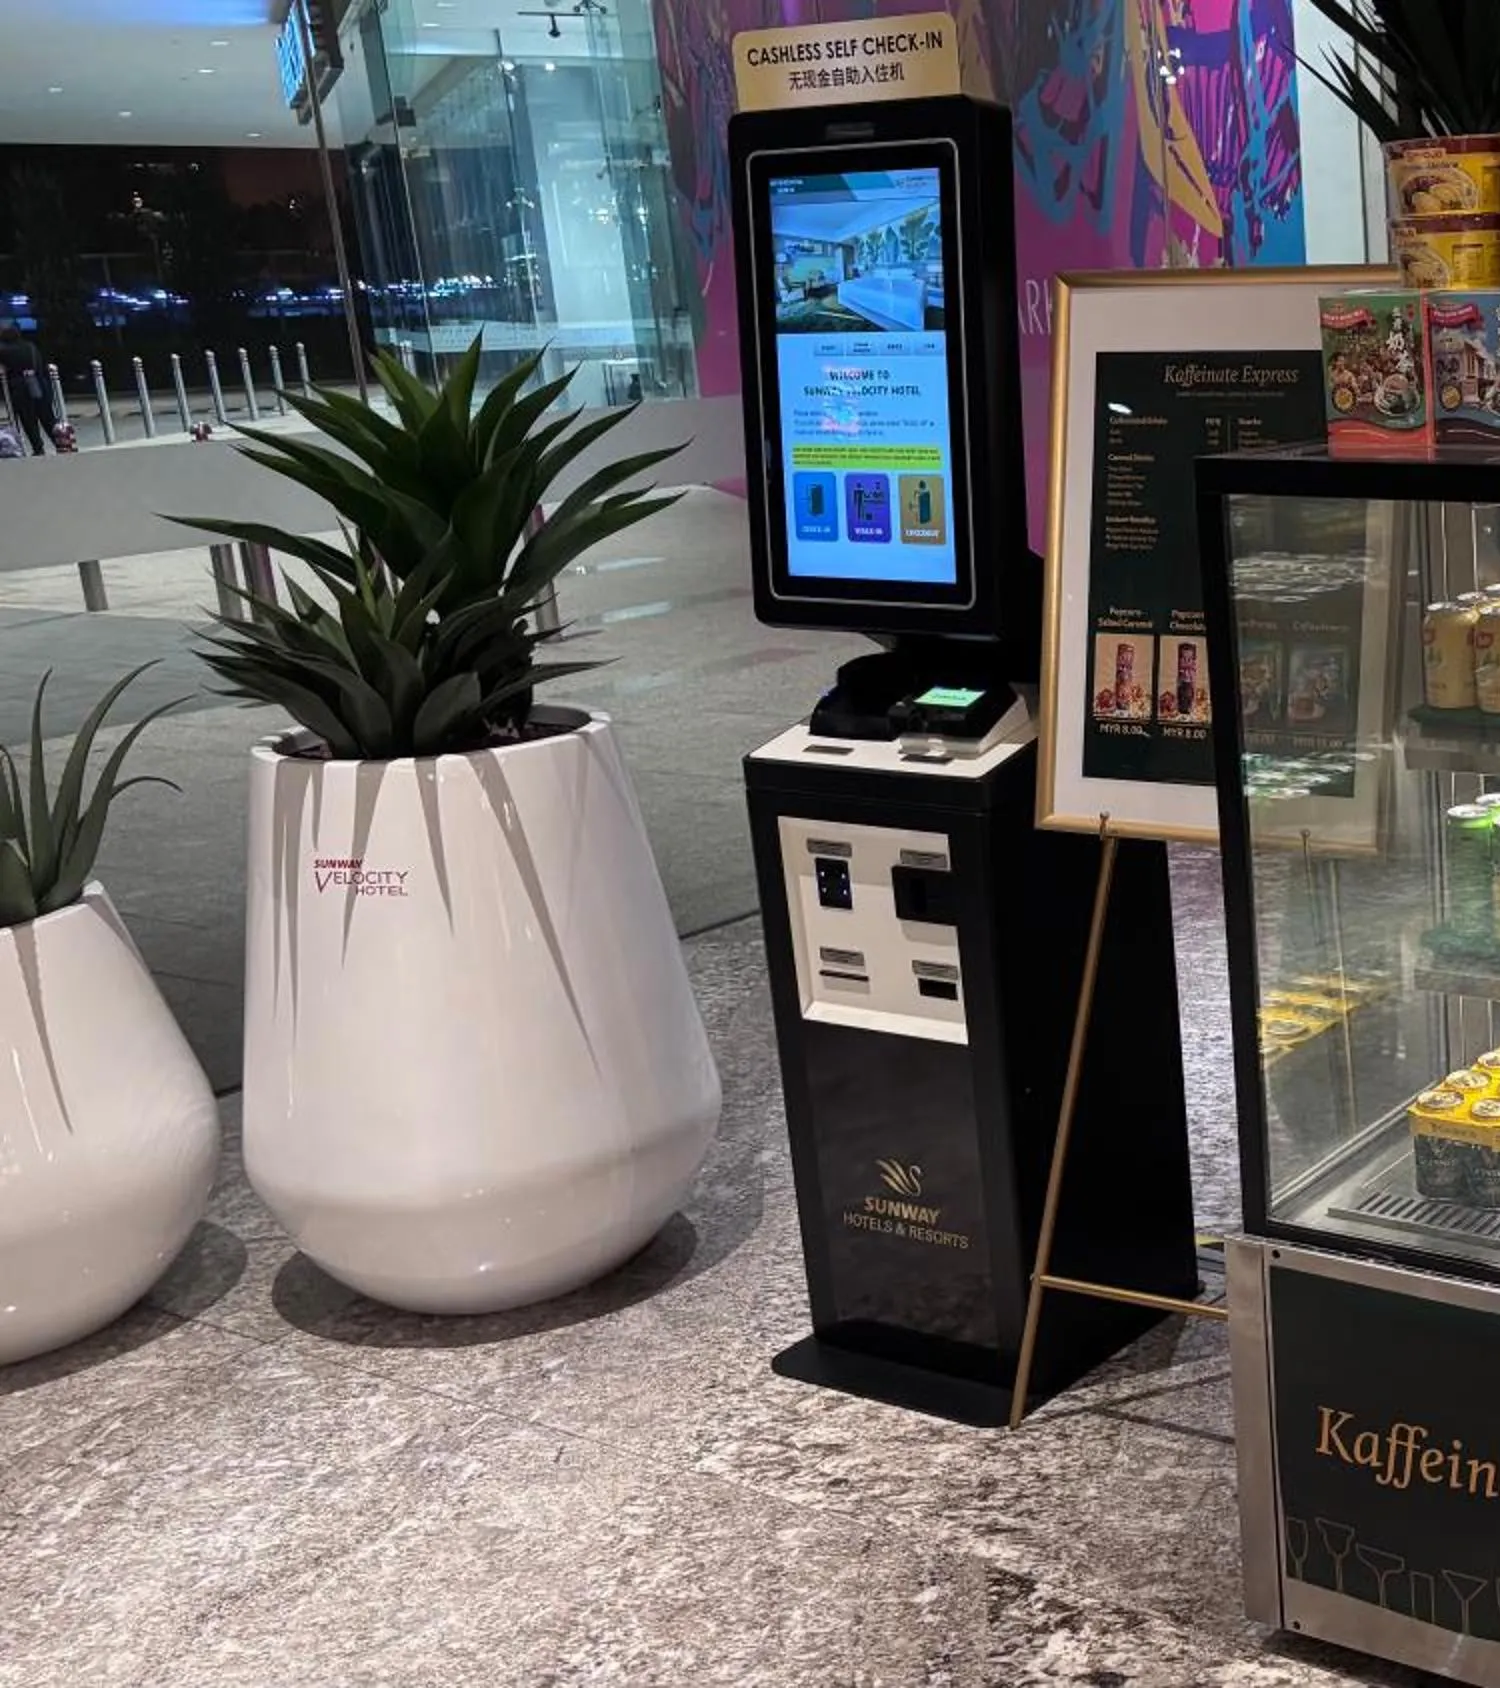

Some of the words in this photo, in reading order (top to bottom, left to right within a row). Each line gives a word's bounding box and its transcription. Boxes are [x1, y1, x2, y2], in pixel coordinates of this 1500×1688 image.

[747, 41, 822, 66] CASHLESS
[825, 39, 857, 61] SELF
[863, 31, 943, 56] CHECK-IN
[789, 62, 905, 90] 无现金自助入住机
[1164, 364, 1240, 387] Kaffeinate
[1241, 364, 1299, 386] Express
[1122, 725, 1142, 736] 8.00
[1185, 729, 1207, 740] 8.00
[313, 858, 364, 869] SUNWAY
[315, 871, 409, 893] VELOCITY
[355, 885, 408, 896] HOTEL
[863, 1196, 941, 1225] SUNWAY
[843, 1212, 893, 1234] HOTELS
[895, 1223, 905, 1236] &
[908, 1225, 969, 1249] RESORTS
